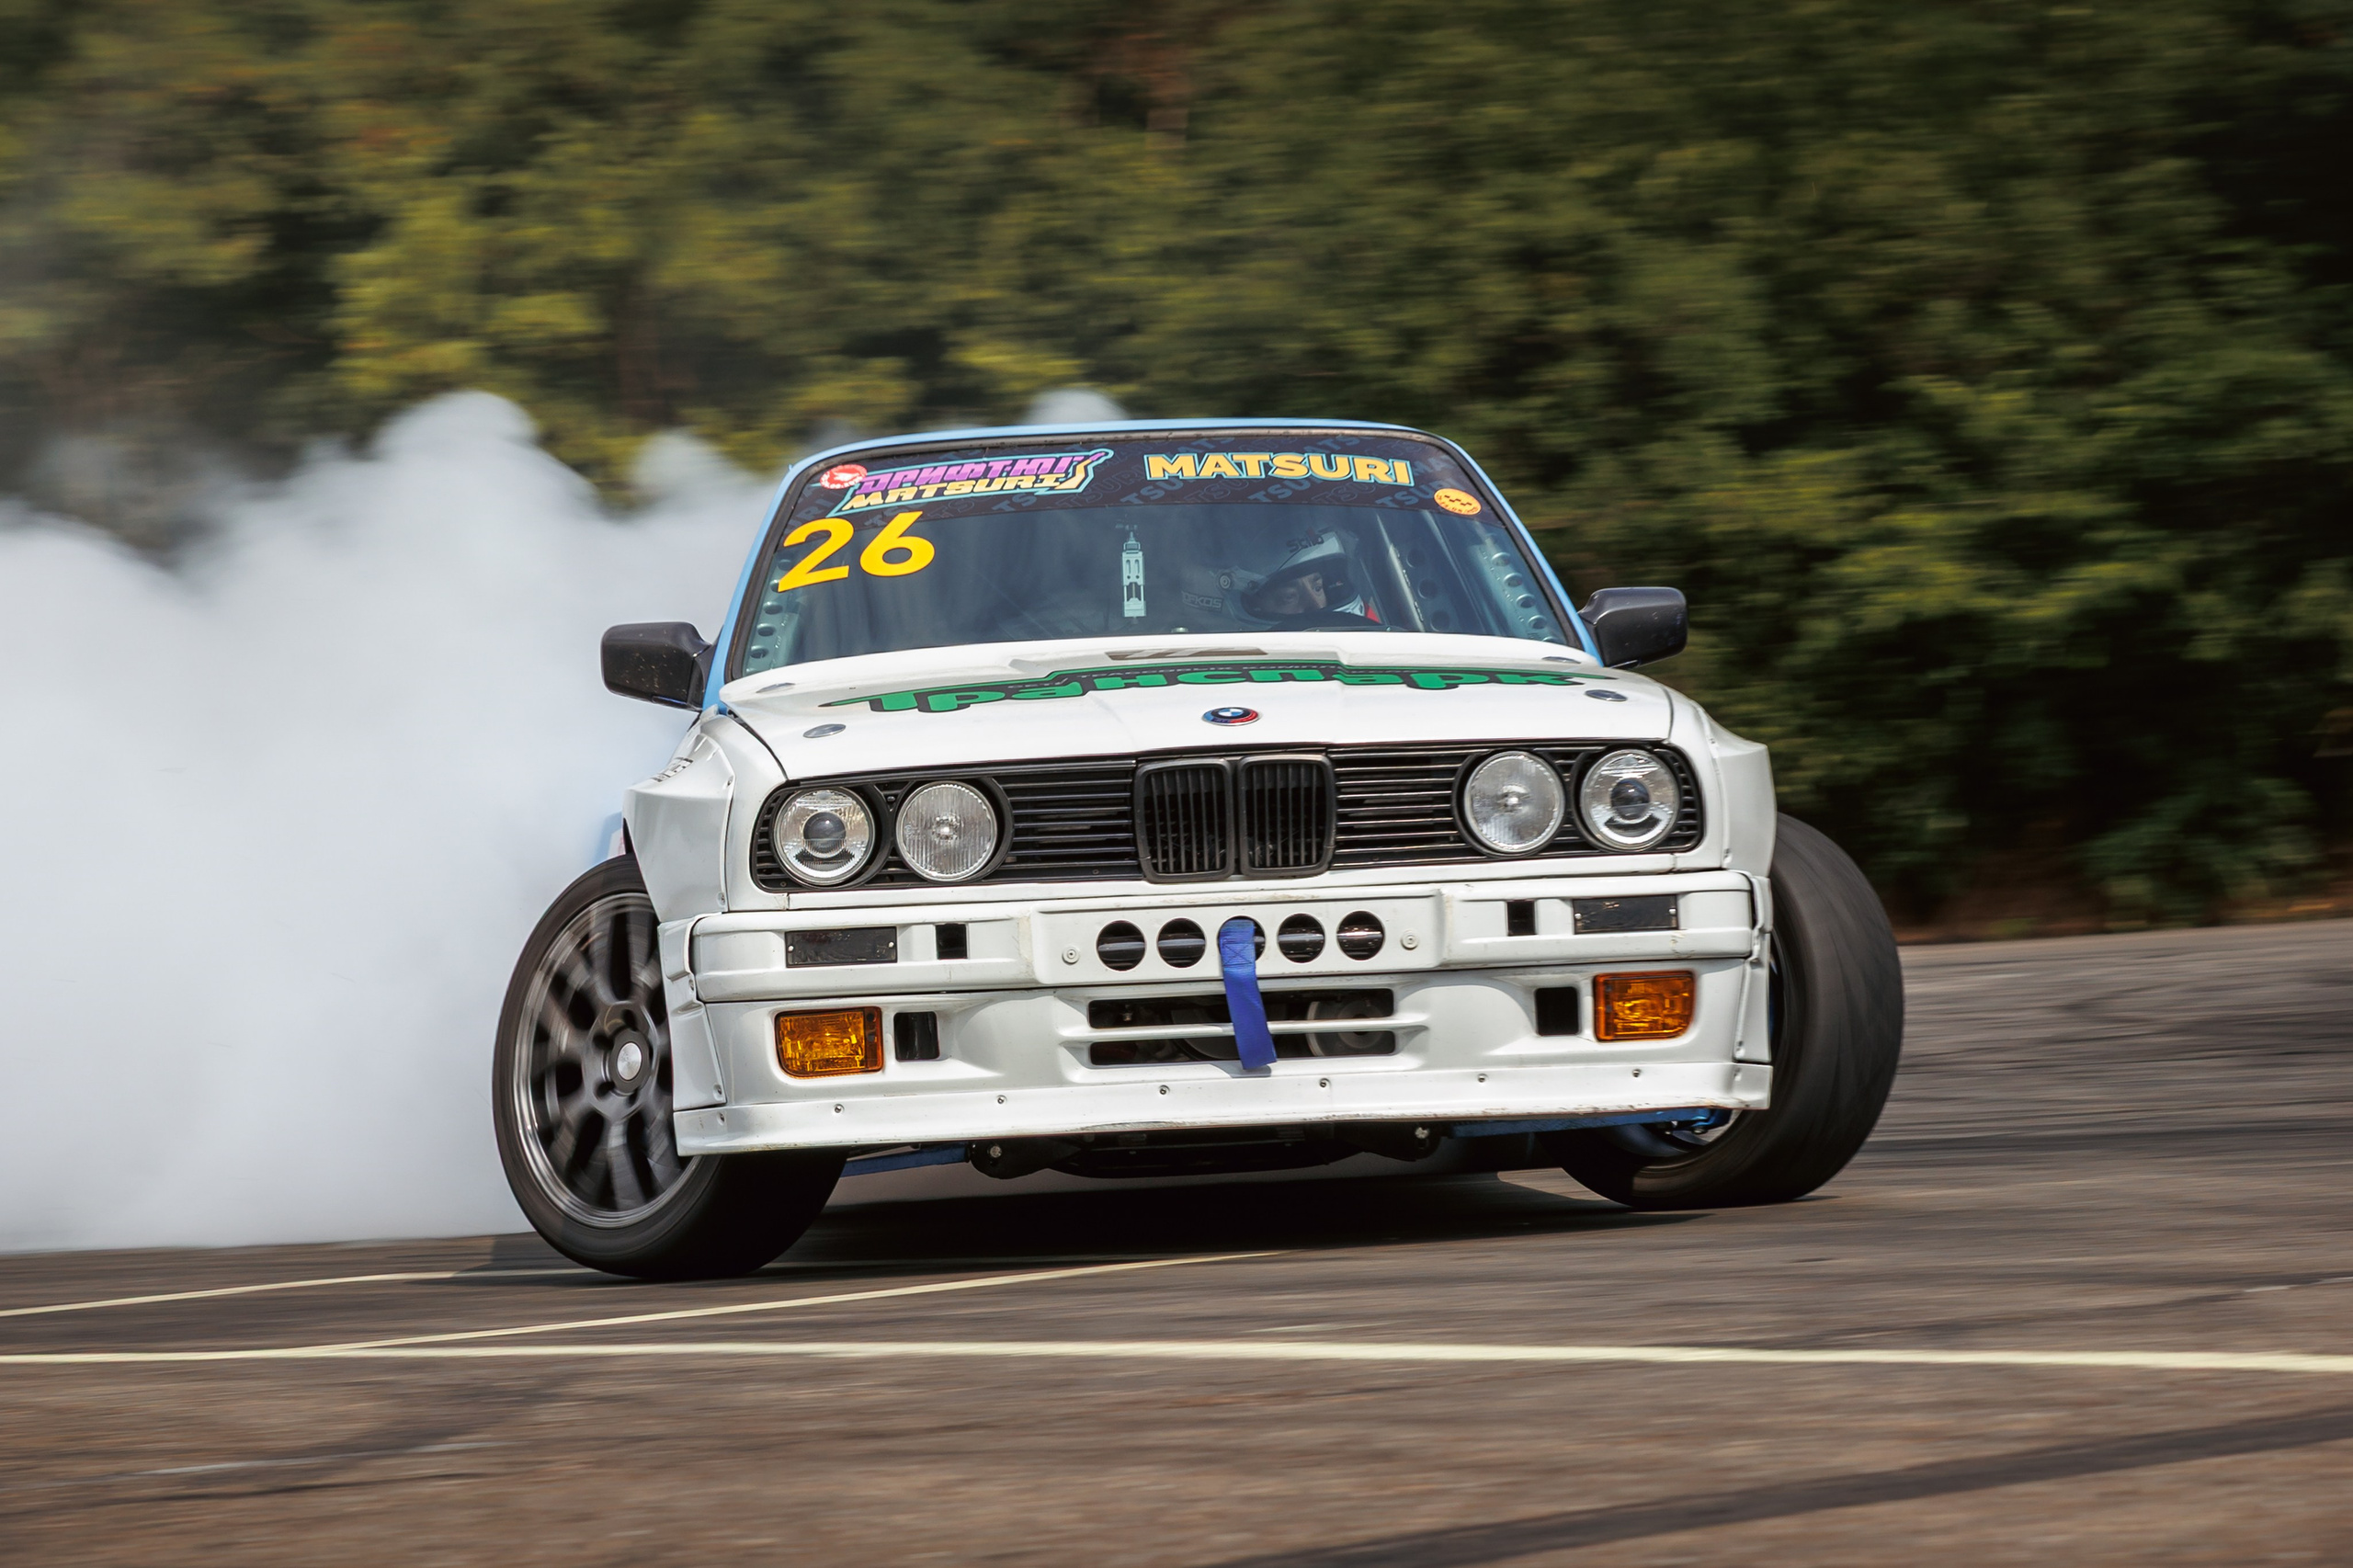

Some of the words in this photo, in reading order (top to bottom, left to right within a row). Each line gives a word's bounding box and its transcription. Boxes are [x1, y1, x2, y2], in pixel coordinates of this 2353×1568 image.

[1144, 452, 1415, 487] MATSURI
[841, 472, 1067, 511] MATSURI
[778, 511, 936, 593] 26
